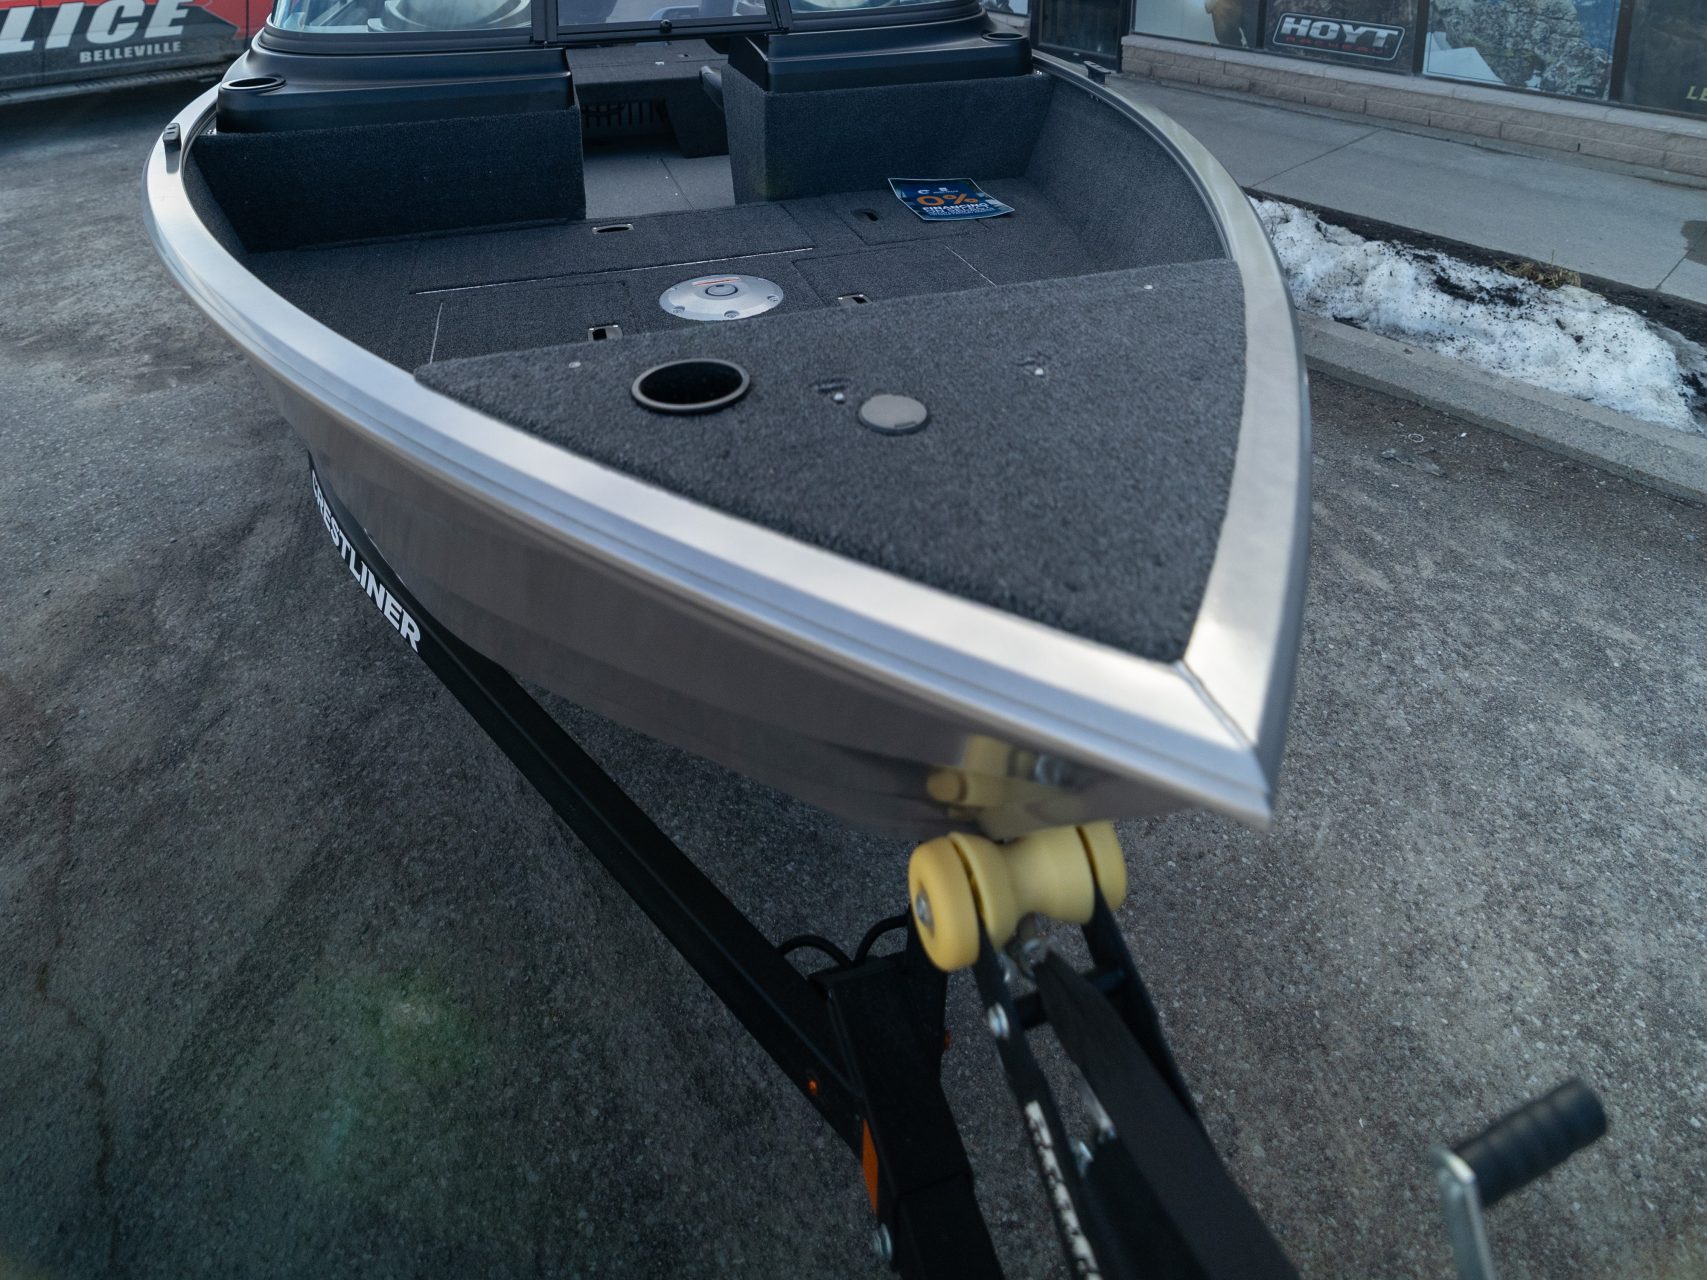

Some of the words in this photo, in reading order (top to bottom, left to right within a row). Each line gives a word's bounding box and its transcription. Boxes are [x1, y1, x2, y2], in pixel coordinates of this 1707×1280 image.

[1281, 17, 1399, 48] HOYT
[79, 41, 182, 64] BELLEVILLE
[917, 194, 978, 206] 0%
[312, 470, 421, 652] CRESTLINER
